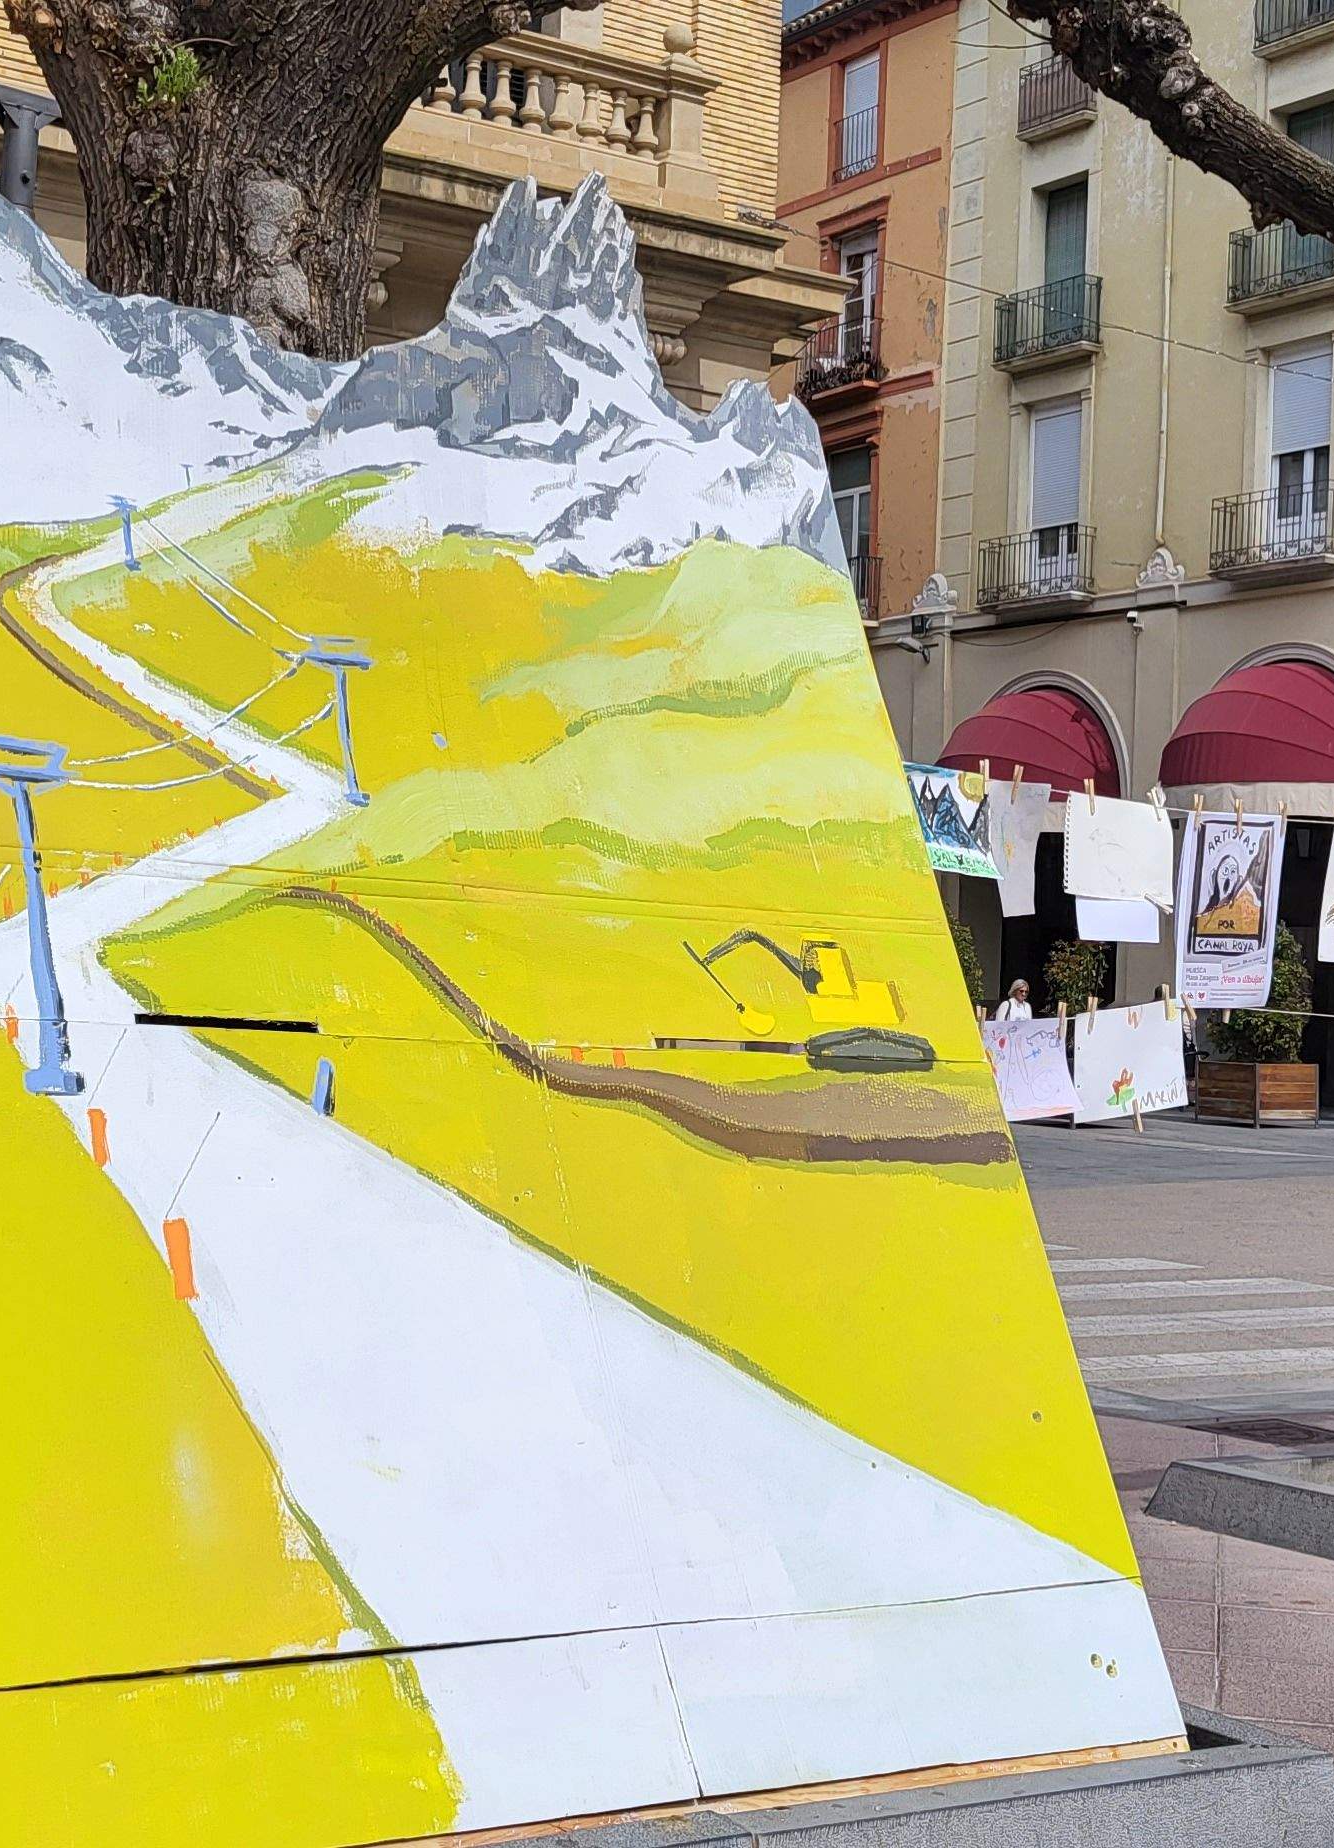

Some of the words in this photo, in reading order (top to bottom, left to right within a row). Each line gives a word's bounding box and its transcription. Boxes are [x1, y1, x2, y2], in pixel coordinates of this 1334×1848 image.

[1208, 828, 1257, 855] ARTISTAS
[1217, 920, 1235, 930] POR
[1197, 938, 1229, 951] CANAL
[1232, 940, 1254, 952] ROYA
